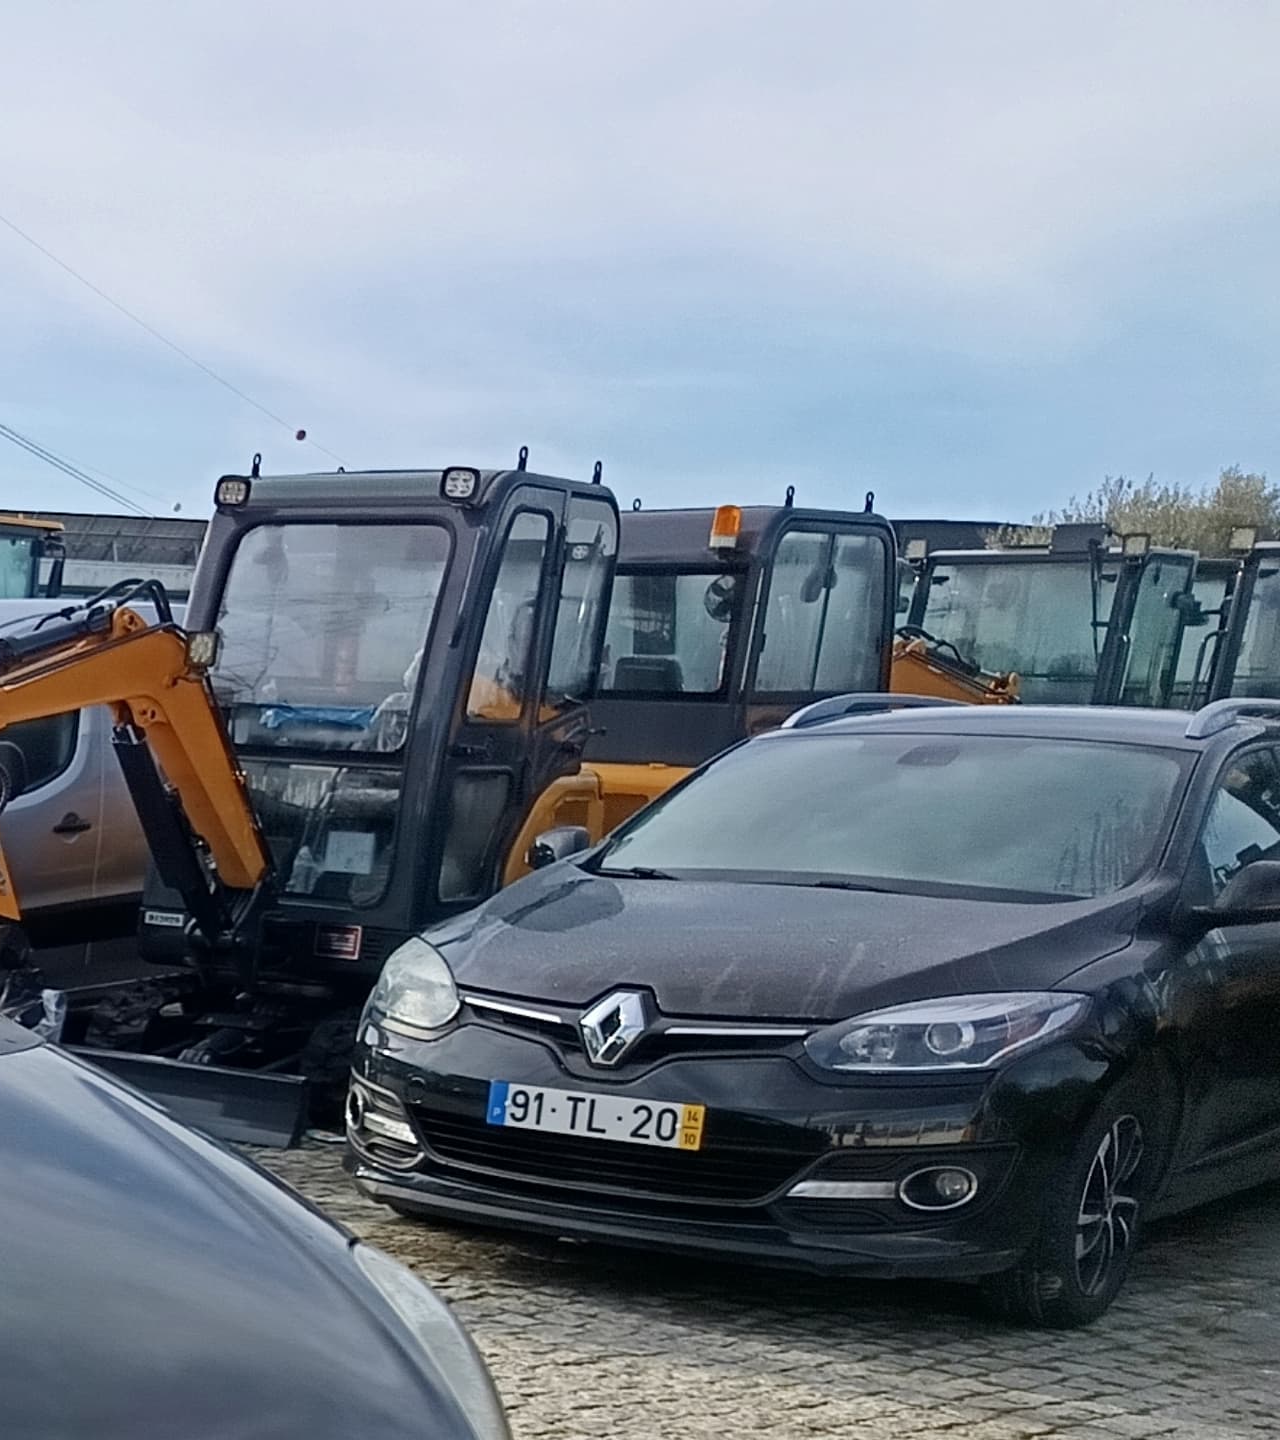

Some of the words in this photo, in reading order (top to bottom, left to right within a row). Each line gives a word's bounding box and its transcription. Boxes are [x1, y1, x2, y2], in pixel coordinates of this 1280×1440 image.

[492, 1107, 501, 1117] P
[687, 1108, 699, 1123] 14
[683, 1132, 696, 1146] 10
